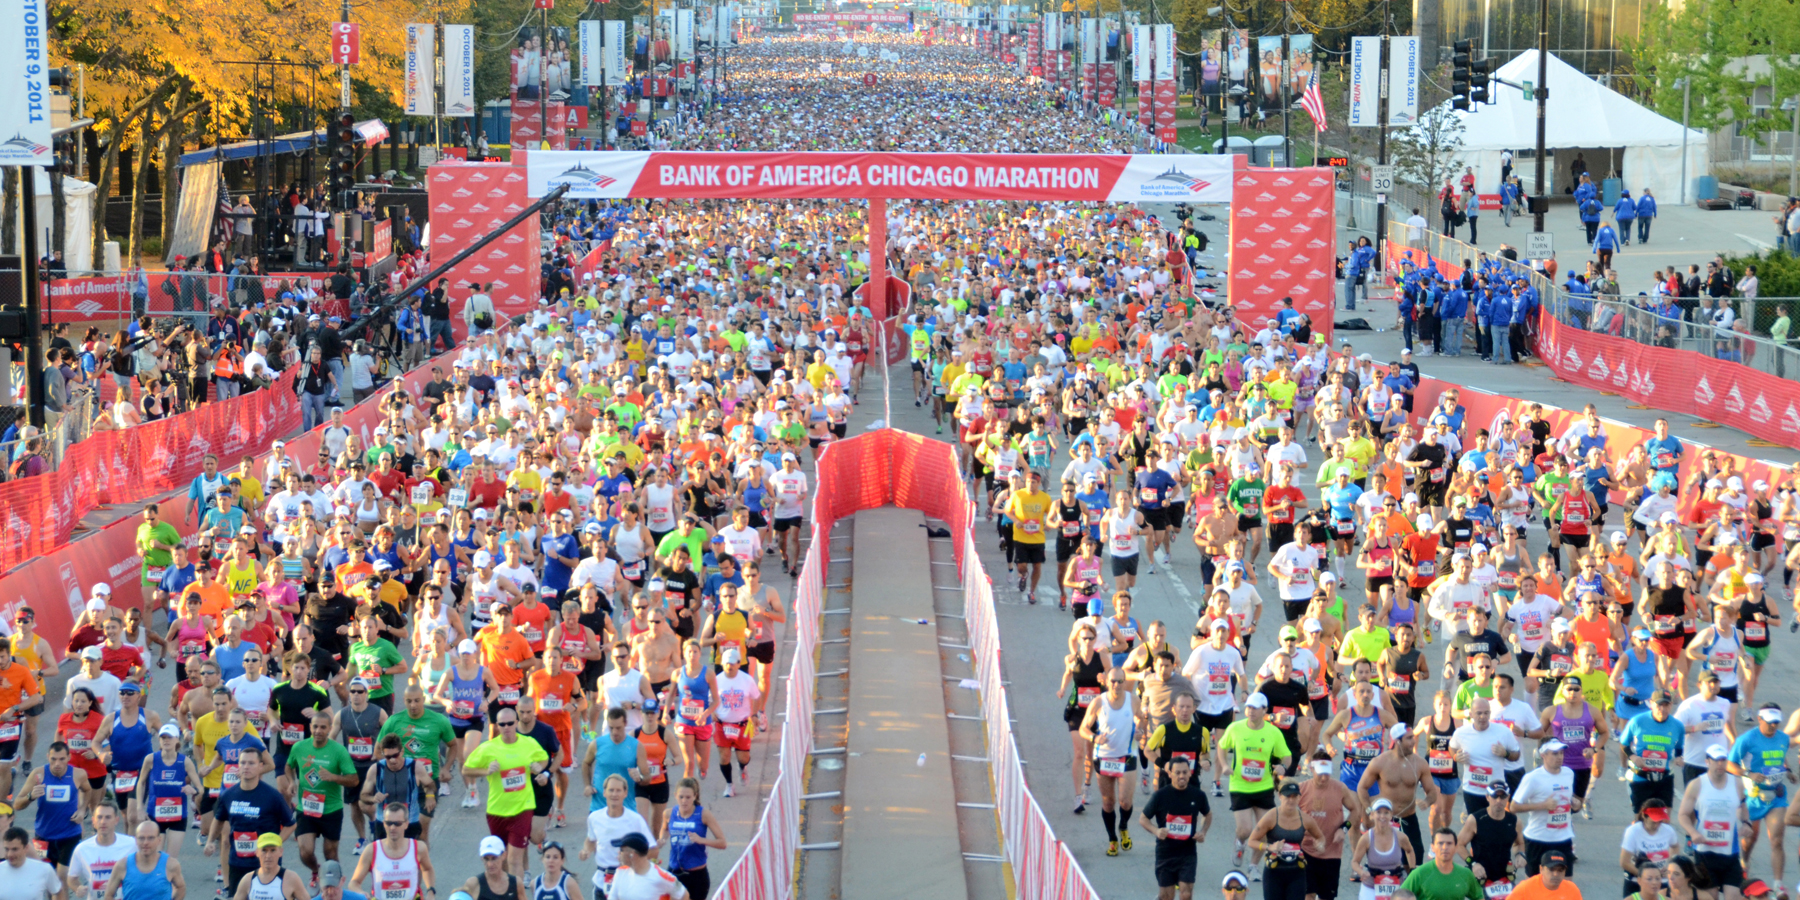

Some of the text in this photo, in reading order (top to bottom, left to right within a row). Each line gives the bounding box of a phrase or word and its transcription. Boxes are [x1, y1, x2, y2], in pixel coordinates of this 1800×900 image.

[1352, 40, 1362, 123] LET'SRUNTOGETHER
[24, 64, 44, 124] 9,2011
[567, 109, 578, 122] A
[1329, 157, 1347, 167] 2:47
[660, 165, 1098, 188] BANK OF AMERICA CHICAGO MARATHON
[1375, 179, 1390, 188] 30
[44, 279, 128, 295] Bank of Americ
[1239, 488, 1262, 498] MEXICO
[234, 579, 252, 593] NF
[667, 580, 685, 589] PEDRO
[68, 739, 88, 748] A1540
[226, 748, 241, 761] KU
